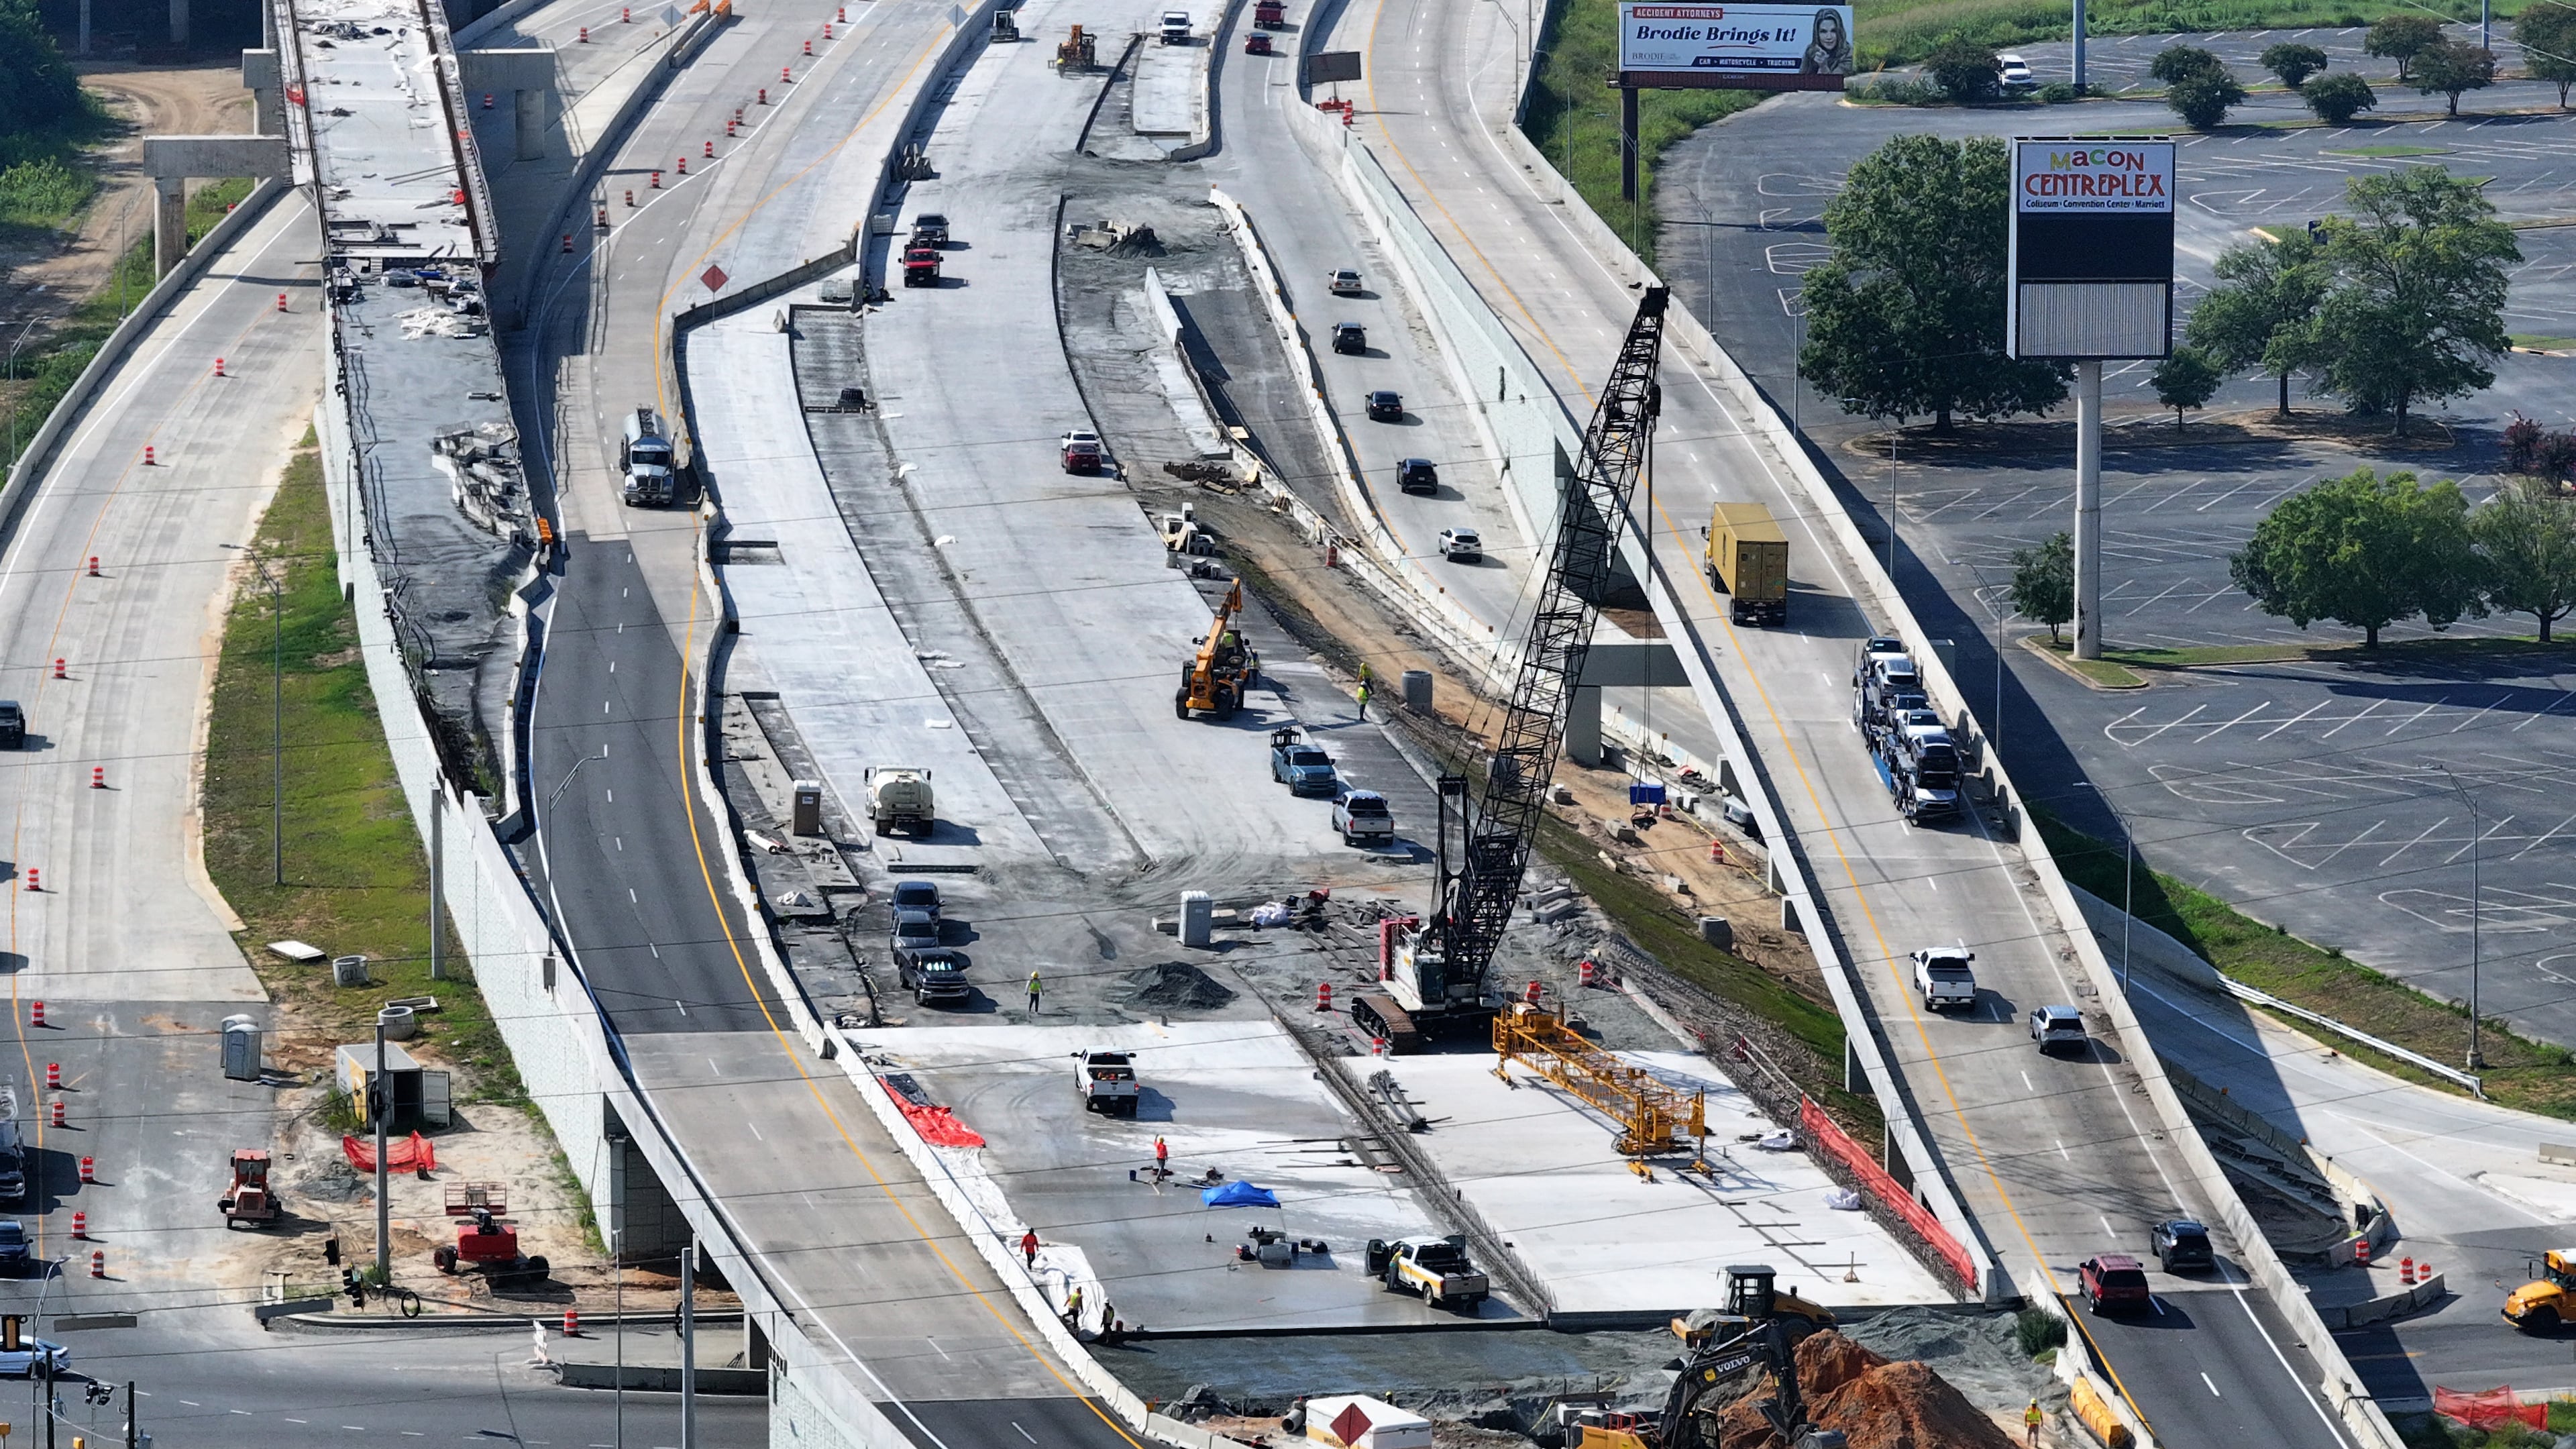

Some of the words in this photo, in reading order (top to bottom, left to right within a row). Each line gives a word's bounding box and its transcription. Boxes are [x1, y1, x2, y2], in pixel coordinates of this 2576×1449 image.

[1636, 9, 1674, 17] ACCIDENT
[1676, 9, 1721, 18] ATTORNEYS
[1636, 25, 1701, 40] Brodie
[1706, 26, 1770, 45] Brings
[1775, 28, 1797, 42] It!
[2025, 173, 2165, 197] CENTREPLEX
[2026, 199, 2059, 208] Coliseum
[2063, 199, 2105, 208] Convention
[2106, 200, 2131, 208] Center
[2135, 200, 2165, 208] Marriott
[1715, 1355, 1750, 1373] VOLVO
